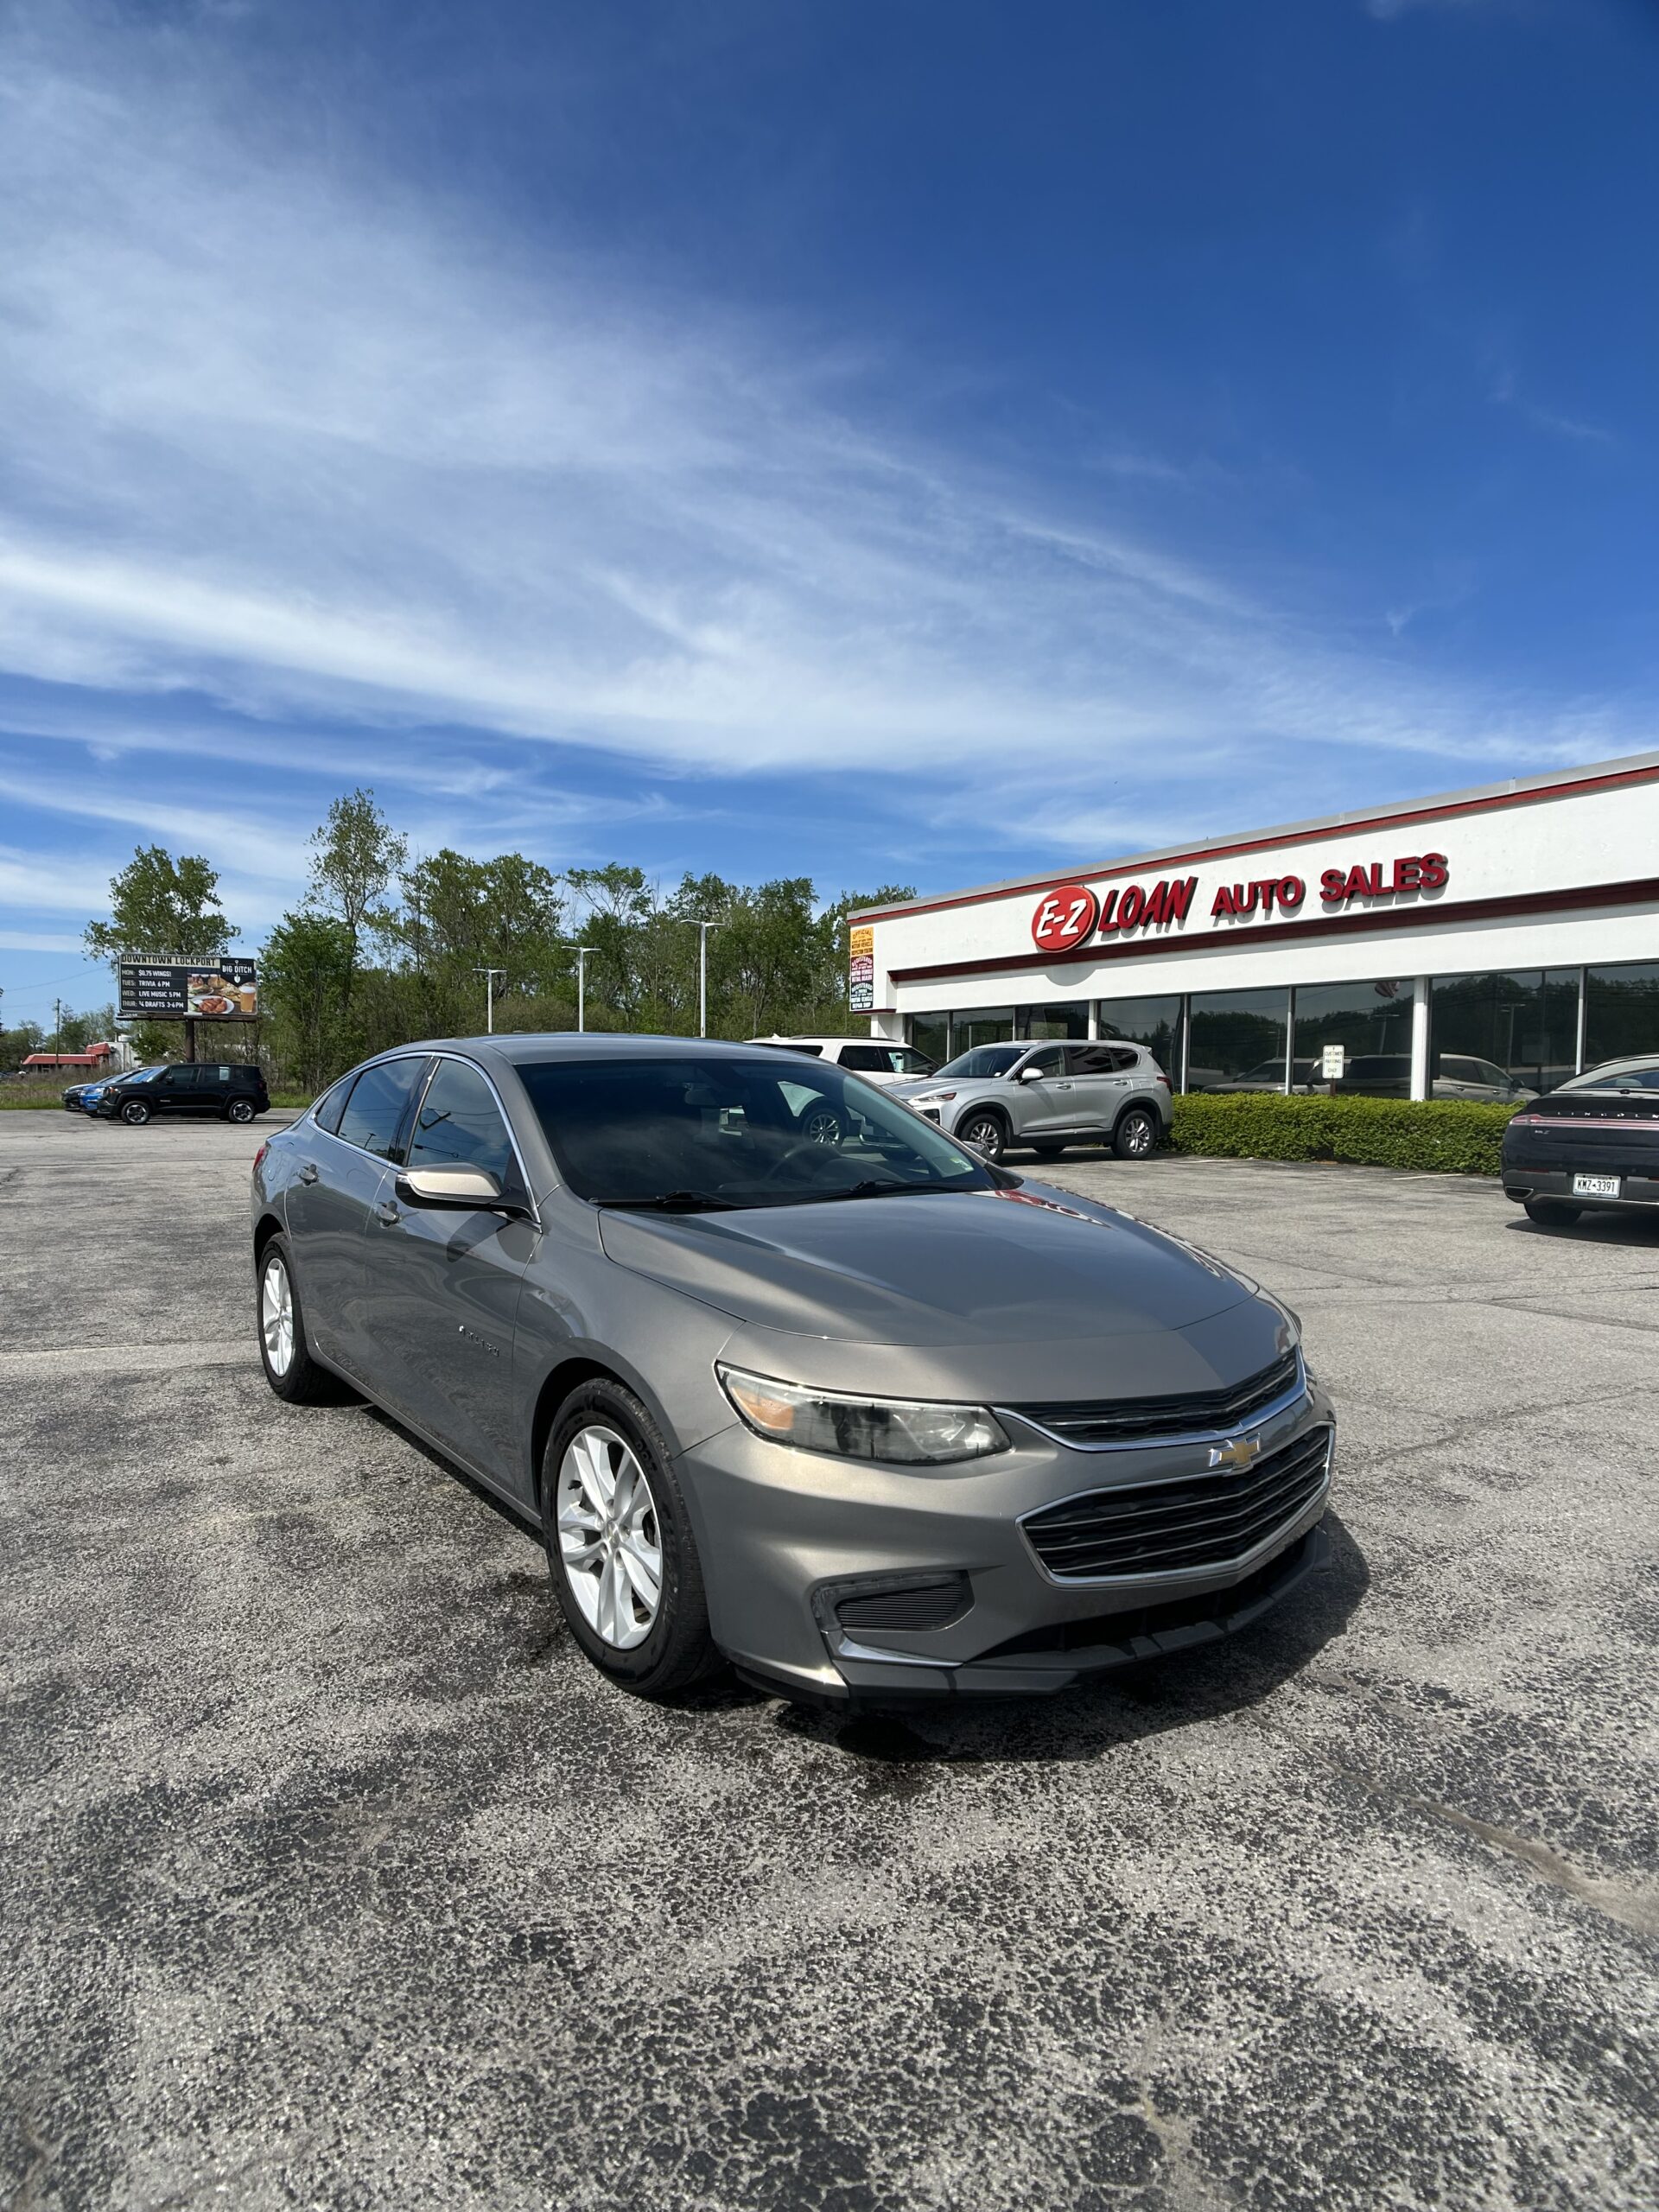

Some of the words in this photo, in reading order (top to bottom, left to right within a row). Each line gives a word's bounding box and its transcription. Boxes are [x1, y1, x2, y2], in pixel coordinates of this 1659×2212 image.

[1037, 899, 1087, 938] E-Z
[1097, 876, 1198, 932] LOAN
[1211, 875, 1306, 916] AUTO
[1319, 852, 1449, 902] SALES
[122, 955, 172, 964] DOWNTOWN
[175, 956, 215, 966] LOCKPORT
[235, 965, 252, 974] DITCH
